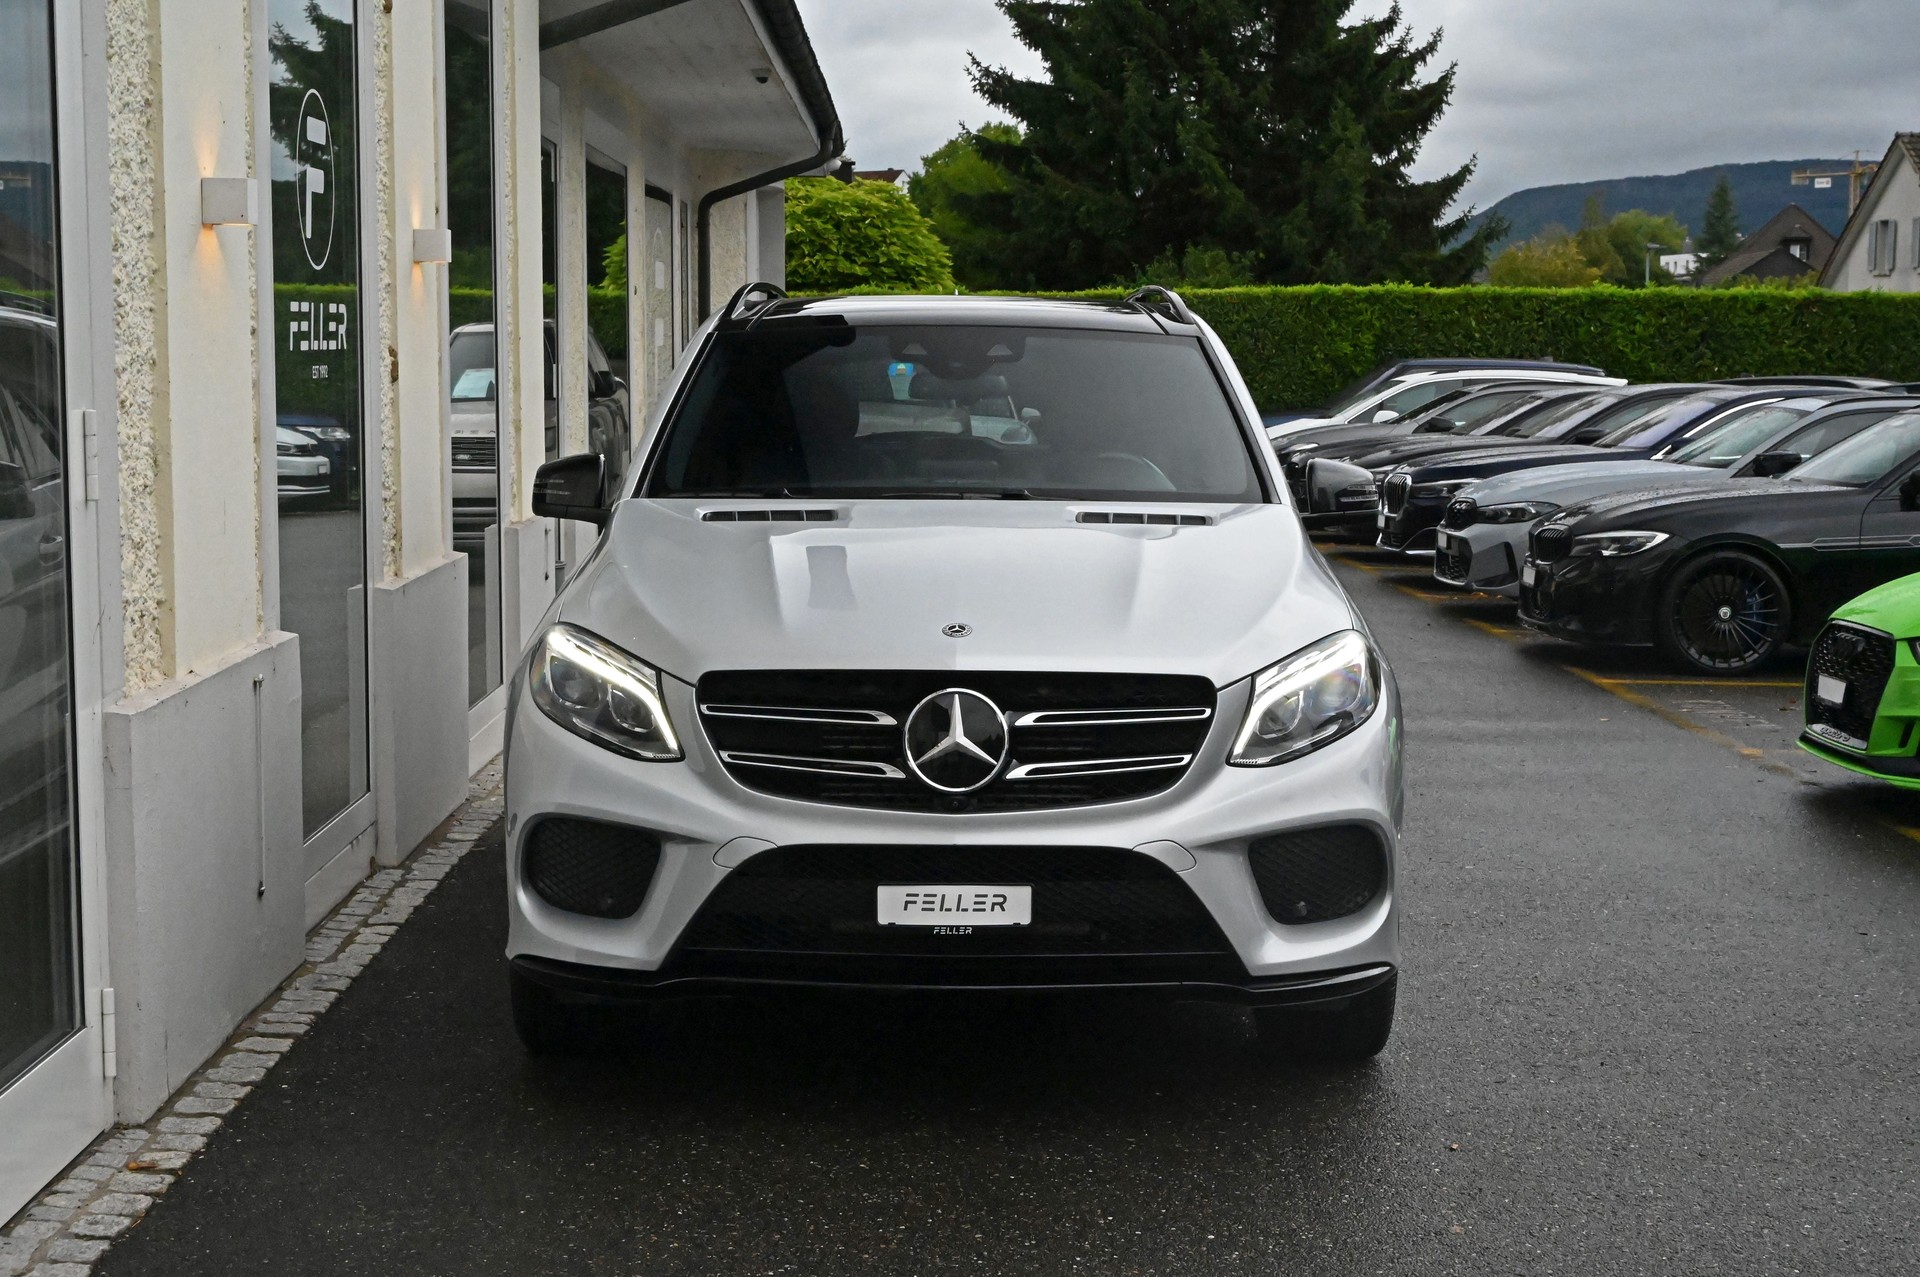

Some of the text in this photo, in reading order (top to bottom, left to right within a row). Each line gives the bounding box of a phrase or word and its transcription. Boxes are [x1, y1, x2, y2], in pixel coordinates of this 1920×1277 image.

[289, 301, 347, 351] FELLER
[903, 893, 1008, 912] FELLER
[933, 926, 973, 935] FELLER
